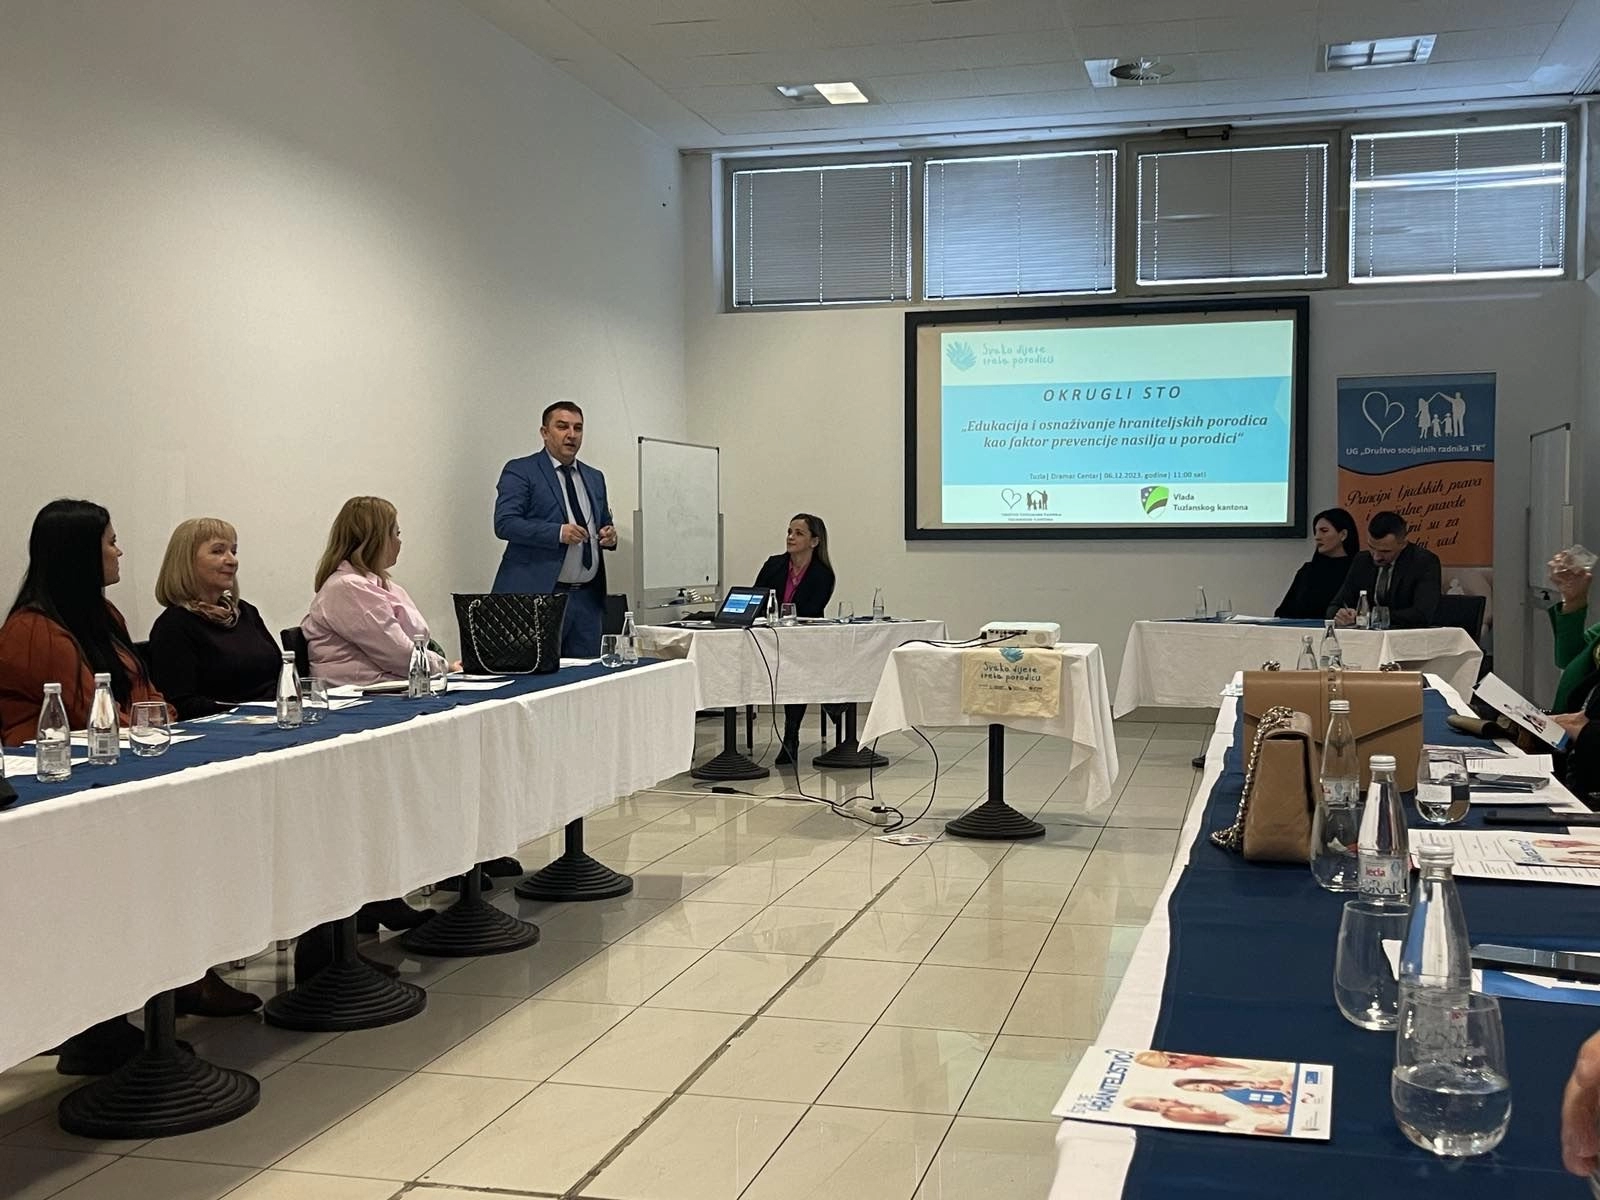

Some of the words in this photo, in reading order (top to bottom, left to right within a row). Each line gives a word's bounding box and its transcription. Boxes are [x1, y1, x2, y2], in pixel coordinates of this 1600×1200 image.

[1043, 388, 1132, 402] OKRUGLI
[1143, 386, 1181, 400] STO
[961, 419, 1029, 434] „Edukacija
[1039, 418, 1116, 432] osnaživanje
[1118, 416, 1204, 430] hraniteljskih
[1207, 414, 1268, 429] porodica
[984, 437, 1007, 448] kao
[1008, 436, 1049, 450] faktor
[1051, 435, 1118, 449] prevencije
[1121, 434, 1166, 448] nasilja
[1169, 436, 1178, 445] u
[1345, 448, 1359, 456] UG
[1398, 446, 1437, 456] socijalnih
[1438, 445, 1469, 454] radnika
[1446, 478, 1483, 496] prava
[1173, 493, 1195, 501] Vlada
[1173, 504, 1215, 512] Tuzlanskog
[1422, 495, 1467, 518] pravde
[1428, 520, 1440, 530] su
[1445, 518, 1460, 529] za
[983, 661, 1010, 673] Svako
[1005, 672, 1041, 684] porodicu
